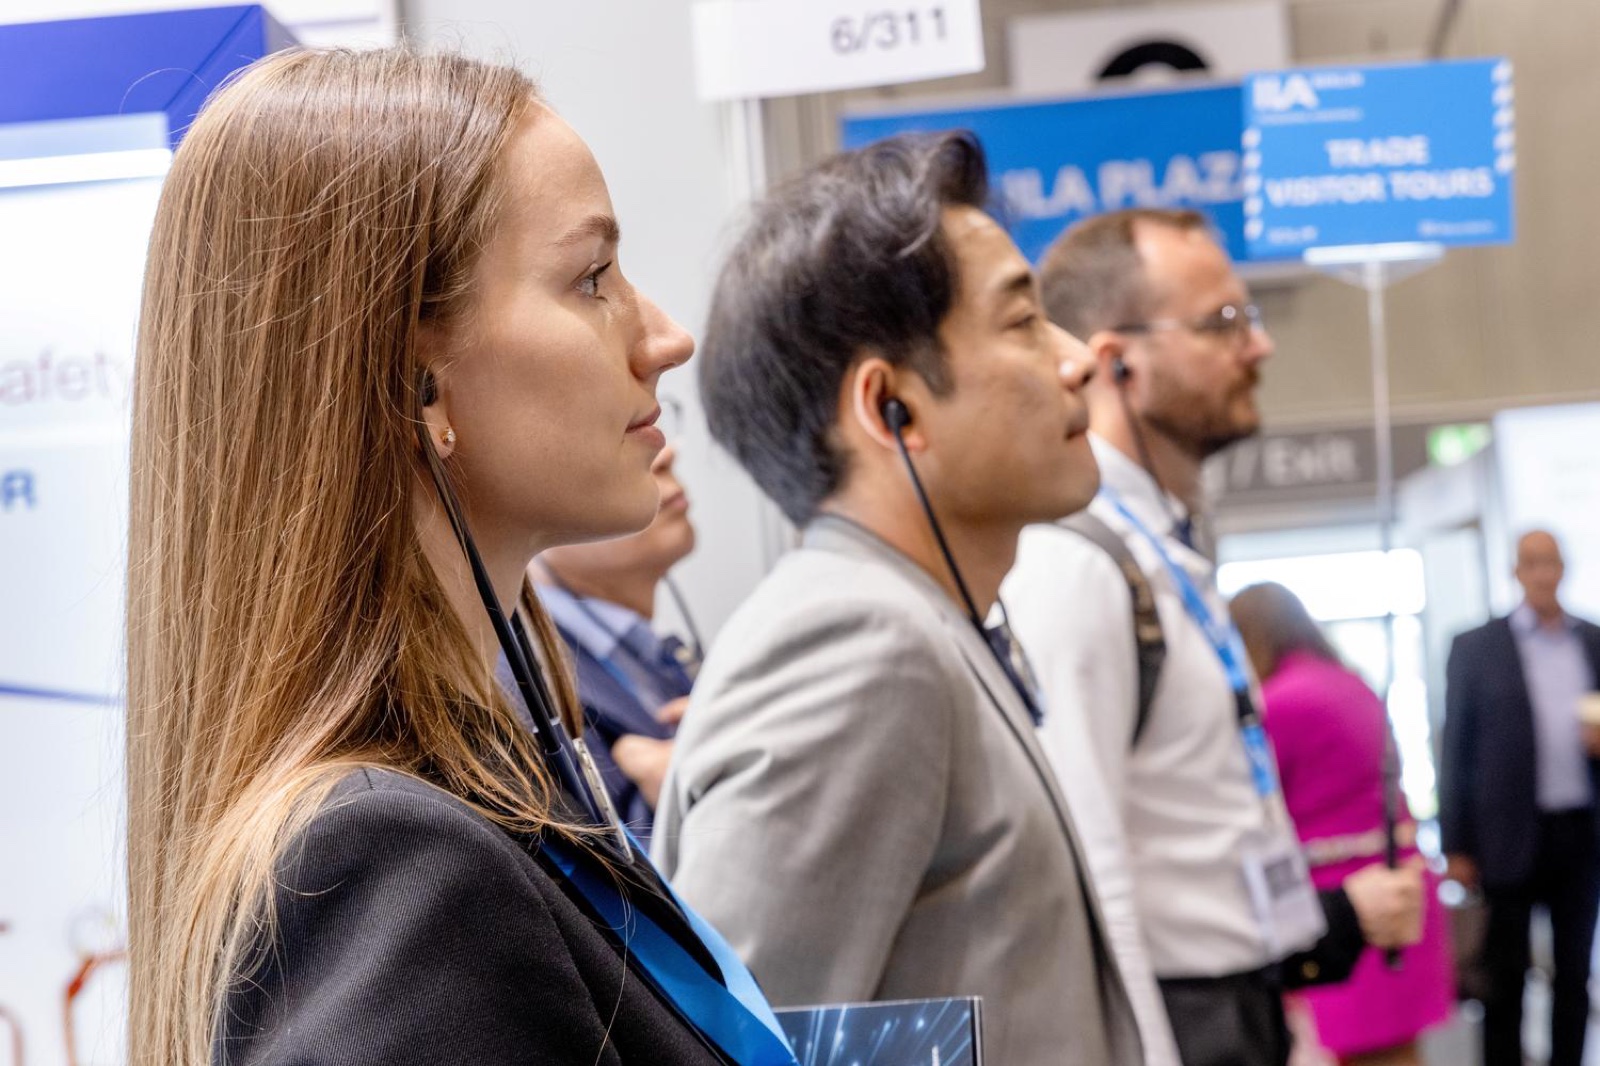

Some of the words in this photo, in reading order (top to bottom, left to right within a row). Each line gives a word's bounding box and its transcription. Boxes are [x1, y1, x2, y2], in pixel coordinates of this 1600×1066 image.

[830, 9, 947, 53] 6/311
[1326, 135, 1430, 168] TRADE
[1098, 150, 1243, 211] PLAZ
[1265, 171, 1387, 207] VISITOR
[1389, 167, 1494, 200] TOURS
